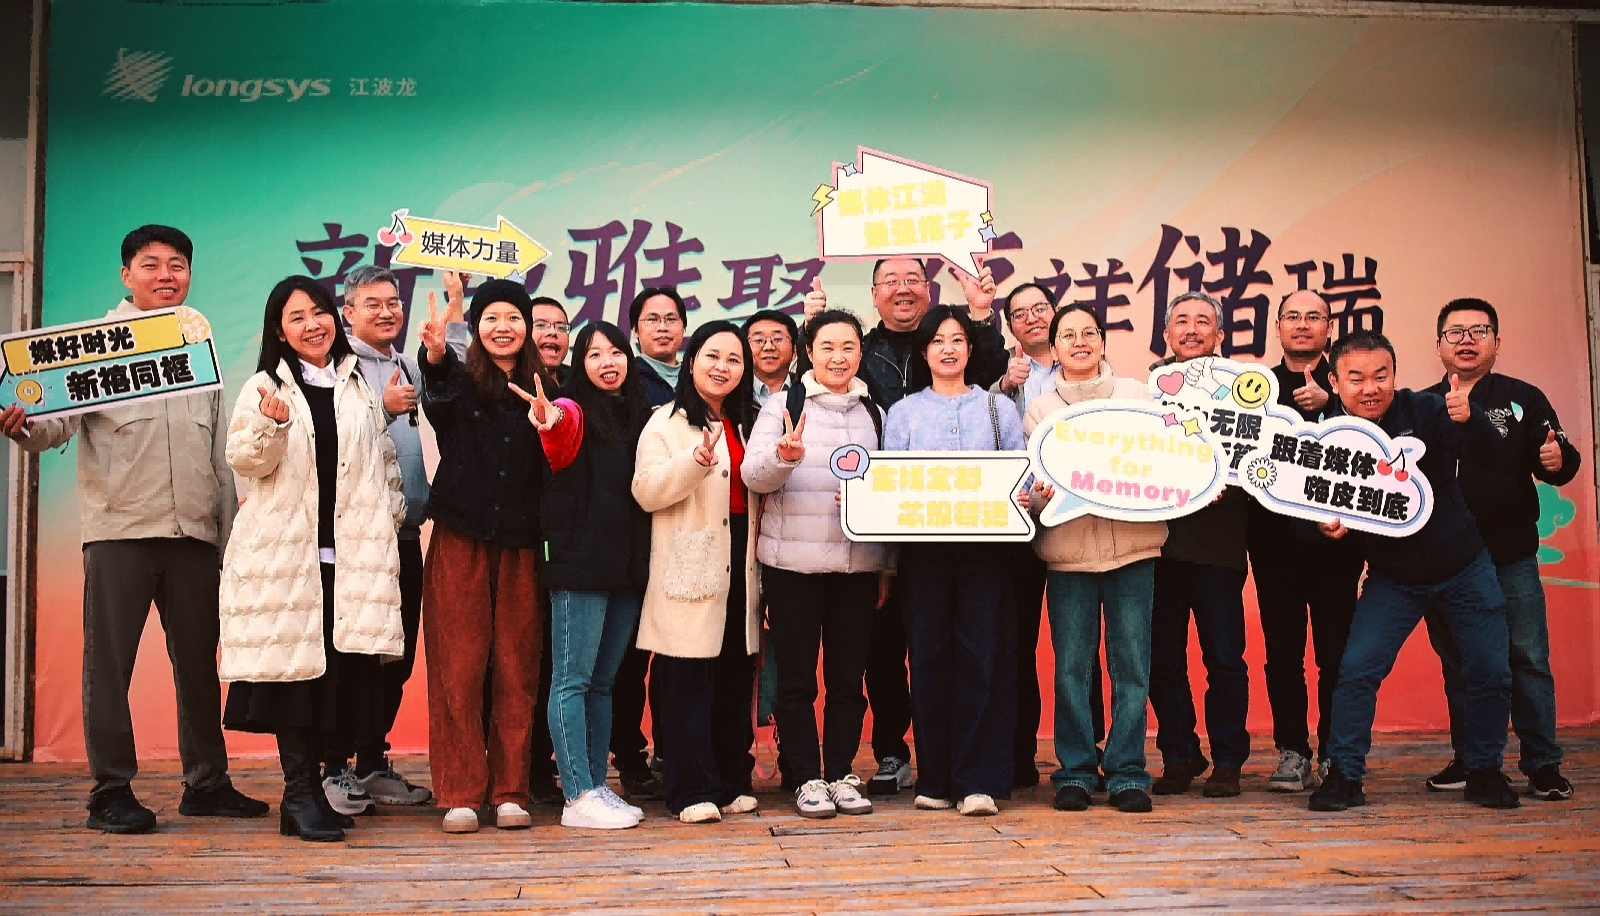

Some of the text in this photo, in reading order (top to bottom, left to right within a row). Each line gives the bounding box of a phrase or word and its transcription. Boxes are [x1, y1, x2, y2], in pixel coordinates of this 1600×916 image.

[181, 74, 331, 102] longsys
[349, 77, 418, 97] 江波龙
[421, 231, 520, 265] 媒体力量
[29, 326, 135, 366] 媒好时光
[66, 352, 195, 402] 新禧同框
[1055, 420, 1214, 463] Everything
[1270, 433, 1378, 480] 跟着媒体
[1110, 456, 1153, 478] for
[1071, 470, 1191, 508] Memory
[1303, 475, 1411, 522] 嗨皮到底
